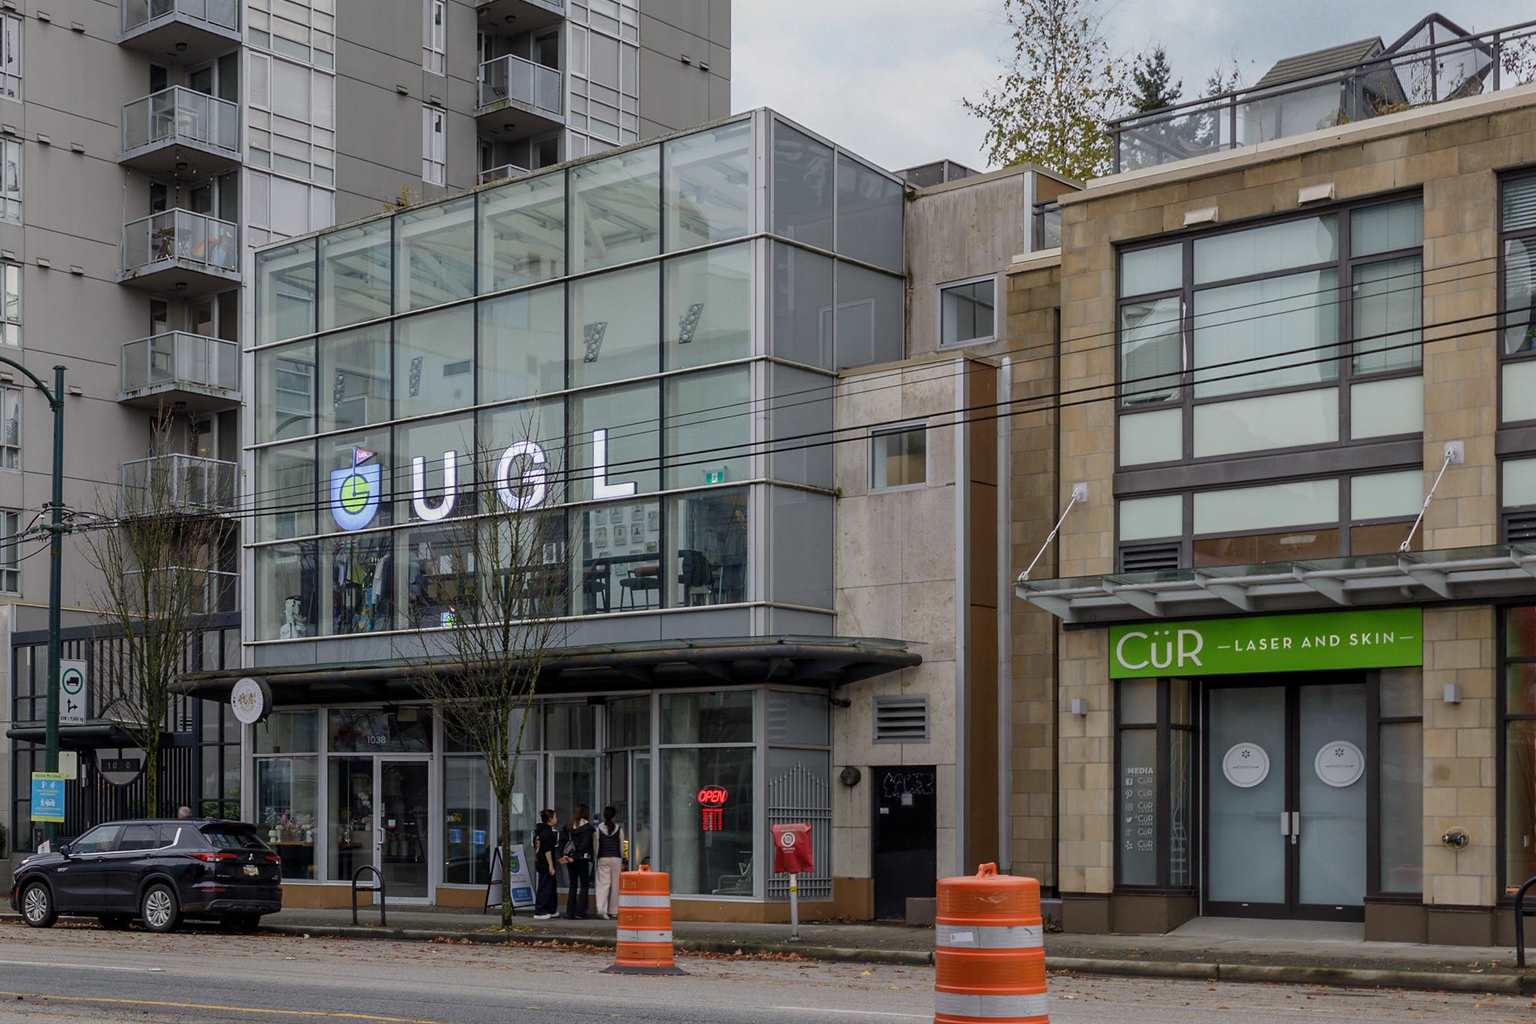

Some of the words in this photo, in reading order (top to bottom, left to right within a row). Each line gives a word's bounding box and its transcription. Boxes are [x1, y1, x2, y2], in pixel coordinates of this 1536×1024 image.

[413, 429, 637, 521] UGL
[1234, 637, 1292, 652] LASER
[1301, 634, 1341, 649] AND
[1349, 631, 1395, 646] SKIN
[367, 735, 386, 744] 1038
[698, 790, 726, 803] OPEN
